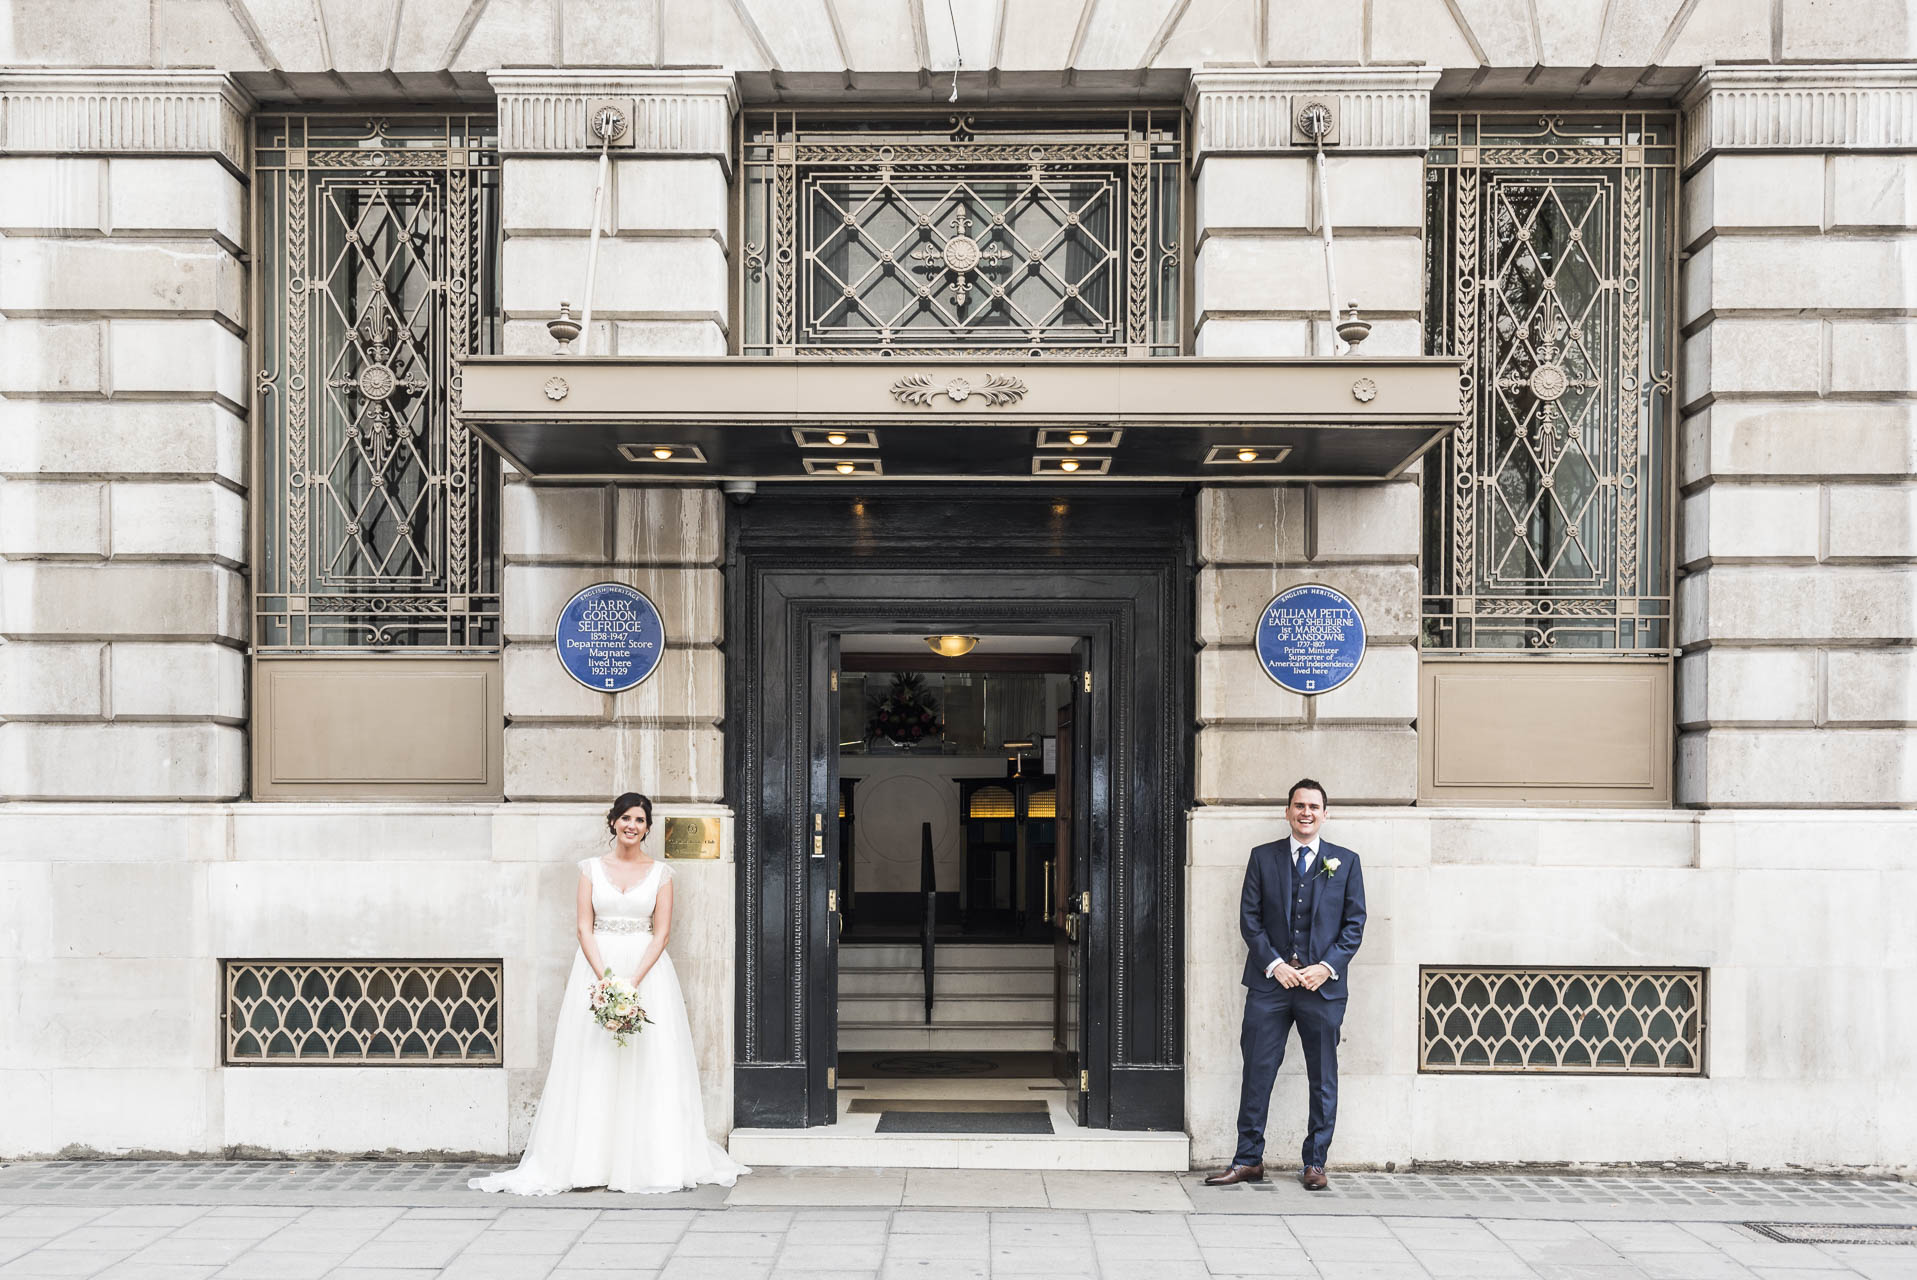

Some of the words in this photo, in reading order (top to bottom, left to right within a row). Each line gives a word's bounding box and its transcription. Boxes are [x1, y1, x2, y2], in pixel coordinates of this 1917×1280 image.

[581, 588, 606, 601] ENGLISH
[609, 588, 639, 600] HERITAGE
[1281, 589, 1308, 602] ENGLISH
[1311, 589, 1342, 603] HERITAGE
[589, 600, 632, 610] HARRY
[583, 611, 636, 620] GORDON
[1270, 609, 1316, 618] WILLIAM
[1320, 609, 1353, 618] PETTY
[578, 621, 642, 632] SELFRIDGE
[567, 639, 625, 650] Department
[629, 640, 653, 648] Store
[589, 649, 630, 660] Magnate
[588, 658, 610, 667] lived
